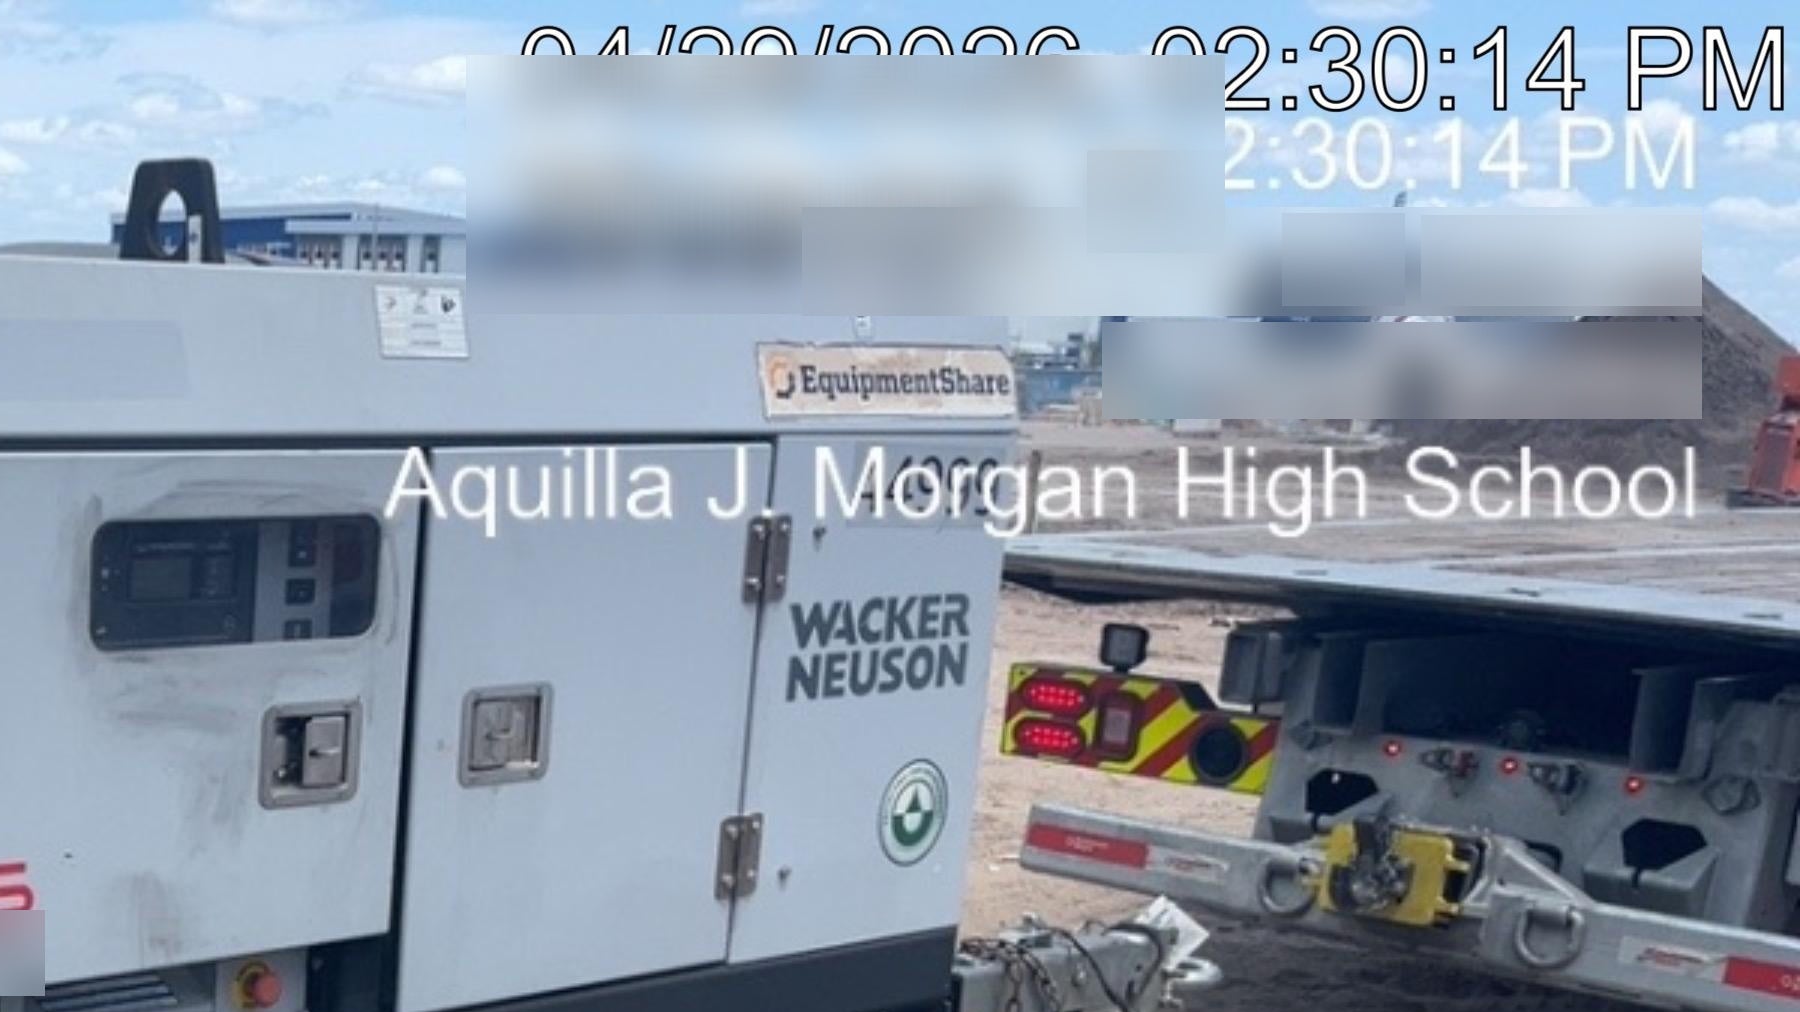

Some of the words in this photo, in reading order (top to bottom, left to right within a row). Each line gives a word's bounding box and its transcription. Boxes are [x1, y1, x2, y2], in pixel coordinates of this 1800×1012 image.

[799, 364, 1011, 400] EquipmentShare
[789, 593, 970, 650] WACKER
[785, 642, 969, 702] NEUSON
